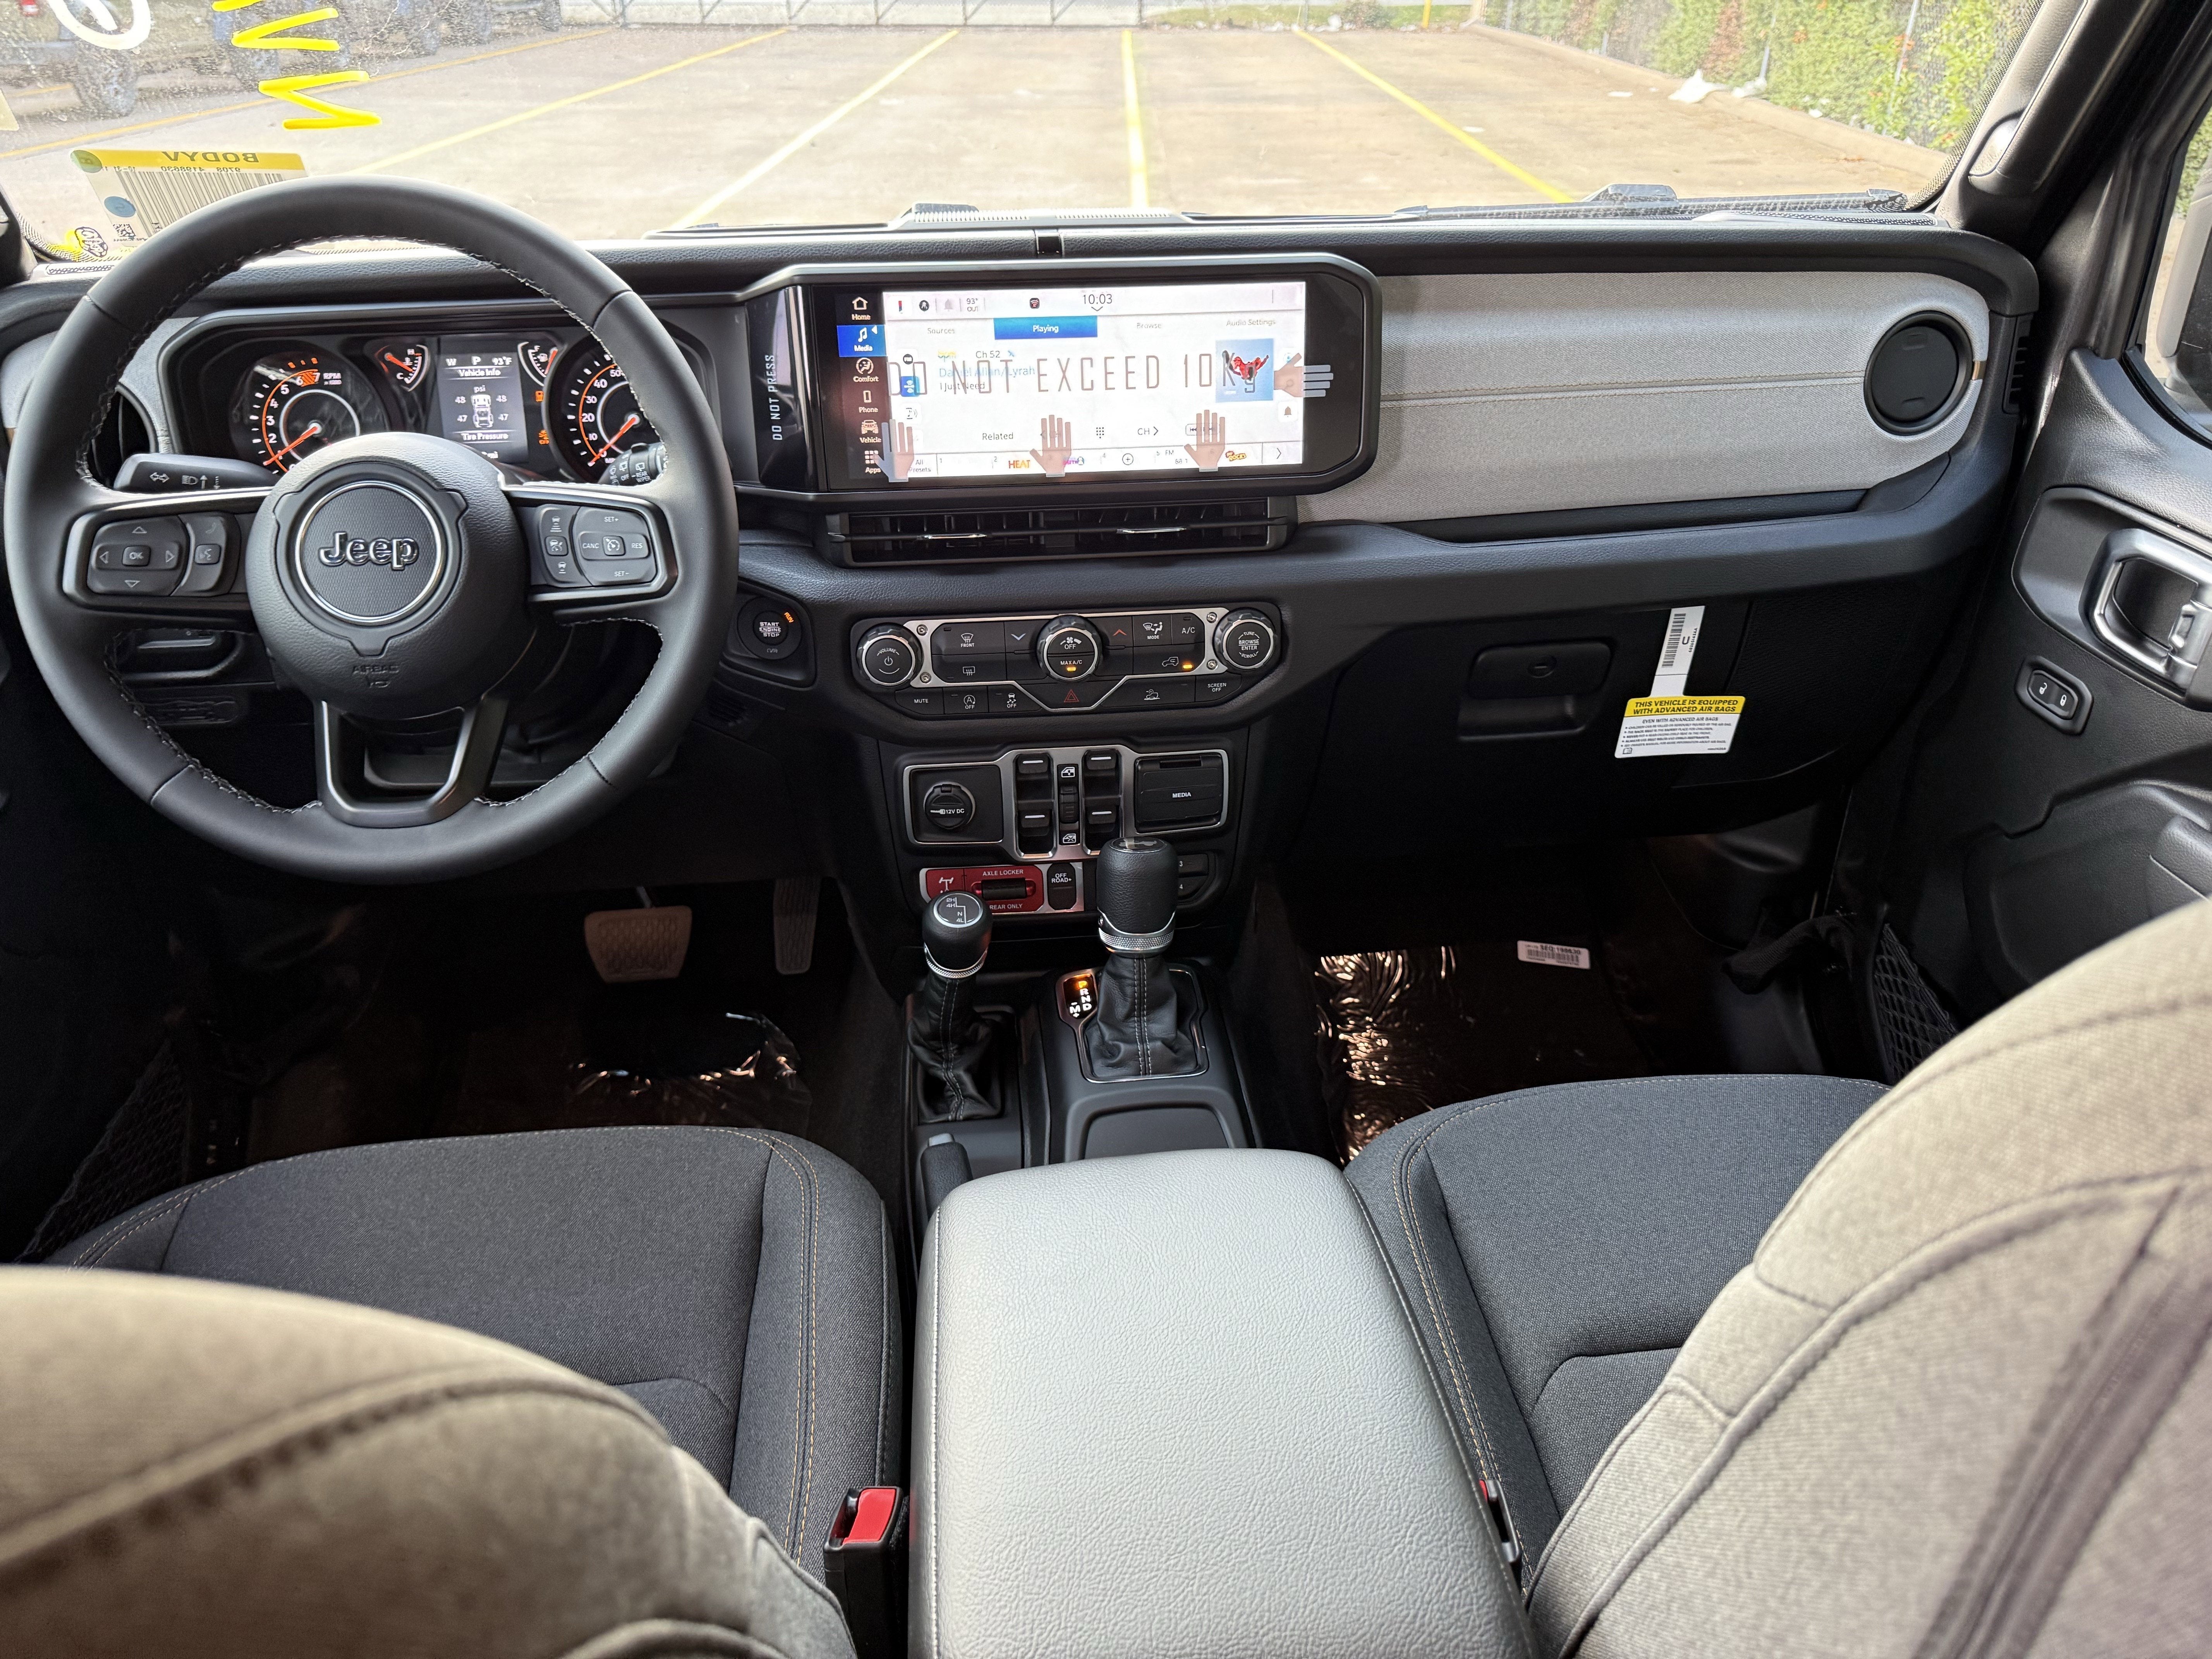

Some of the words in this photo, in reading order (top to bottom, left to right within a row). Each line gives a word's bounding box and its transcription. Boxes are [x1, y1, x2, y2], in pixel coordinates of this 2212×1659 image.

[1082, 294, 1113, 305] 10:03
[1248, 319, 1276, 327] Settings
[1032, 324, 1059, 334] Playing
[472, 356, 481, 365] P
[313, 373, 321, 382] 7
[765, 354, 778, 392] PRESS
[887, 361, 927, 395] DO
[952, 359, 1013, 395] NOT
[1037, 355, 1159, 392] EXCEED
[297, 375, 303, 386] 6
[594, 379, 608, 388] 40
[281, 385, 290, 395] 5
[474, 385, 486, 393] psi
[944, 383, 960, 392] Jut
[270, 399, 278, 408] 4
[769, 398, 781, 420] NOT
[266, 416, 275, 426] 3
[582, 413, 595, 422] 20
[477, 432, 508, 441] Pressure
[771, 424, 783, 441] DO
[269, 433, 277, 443] 2
[1008, 460, 1030, 469] HEAT
[318, 531, 419, 571] Jeep
[129, 552, 144, 560] OK
[784, 612, 794, 623] RUN
[1682, 636, 1690, 645] U
[1083, 1003, 1092, 1011] D
